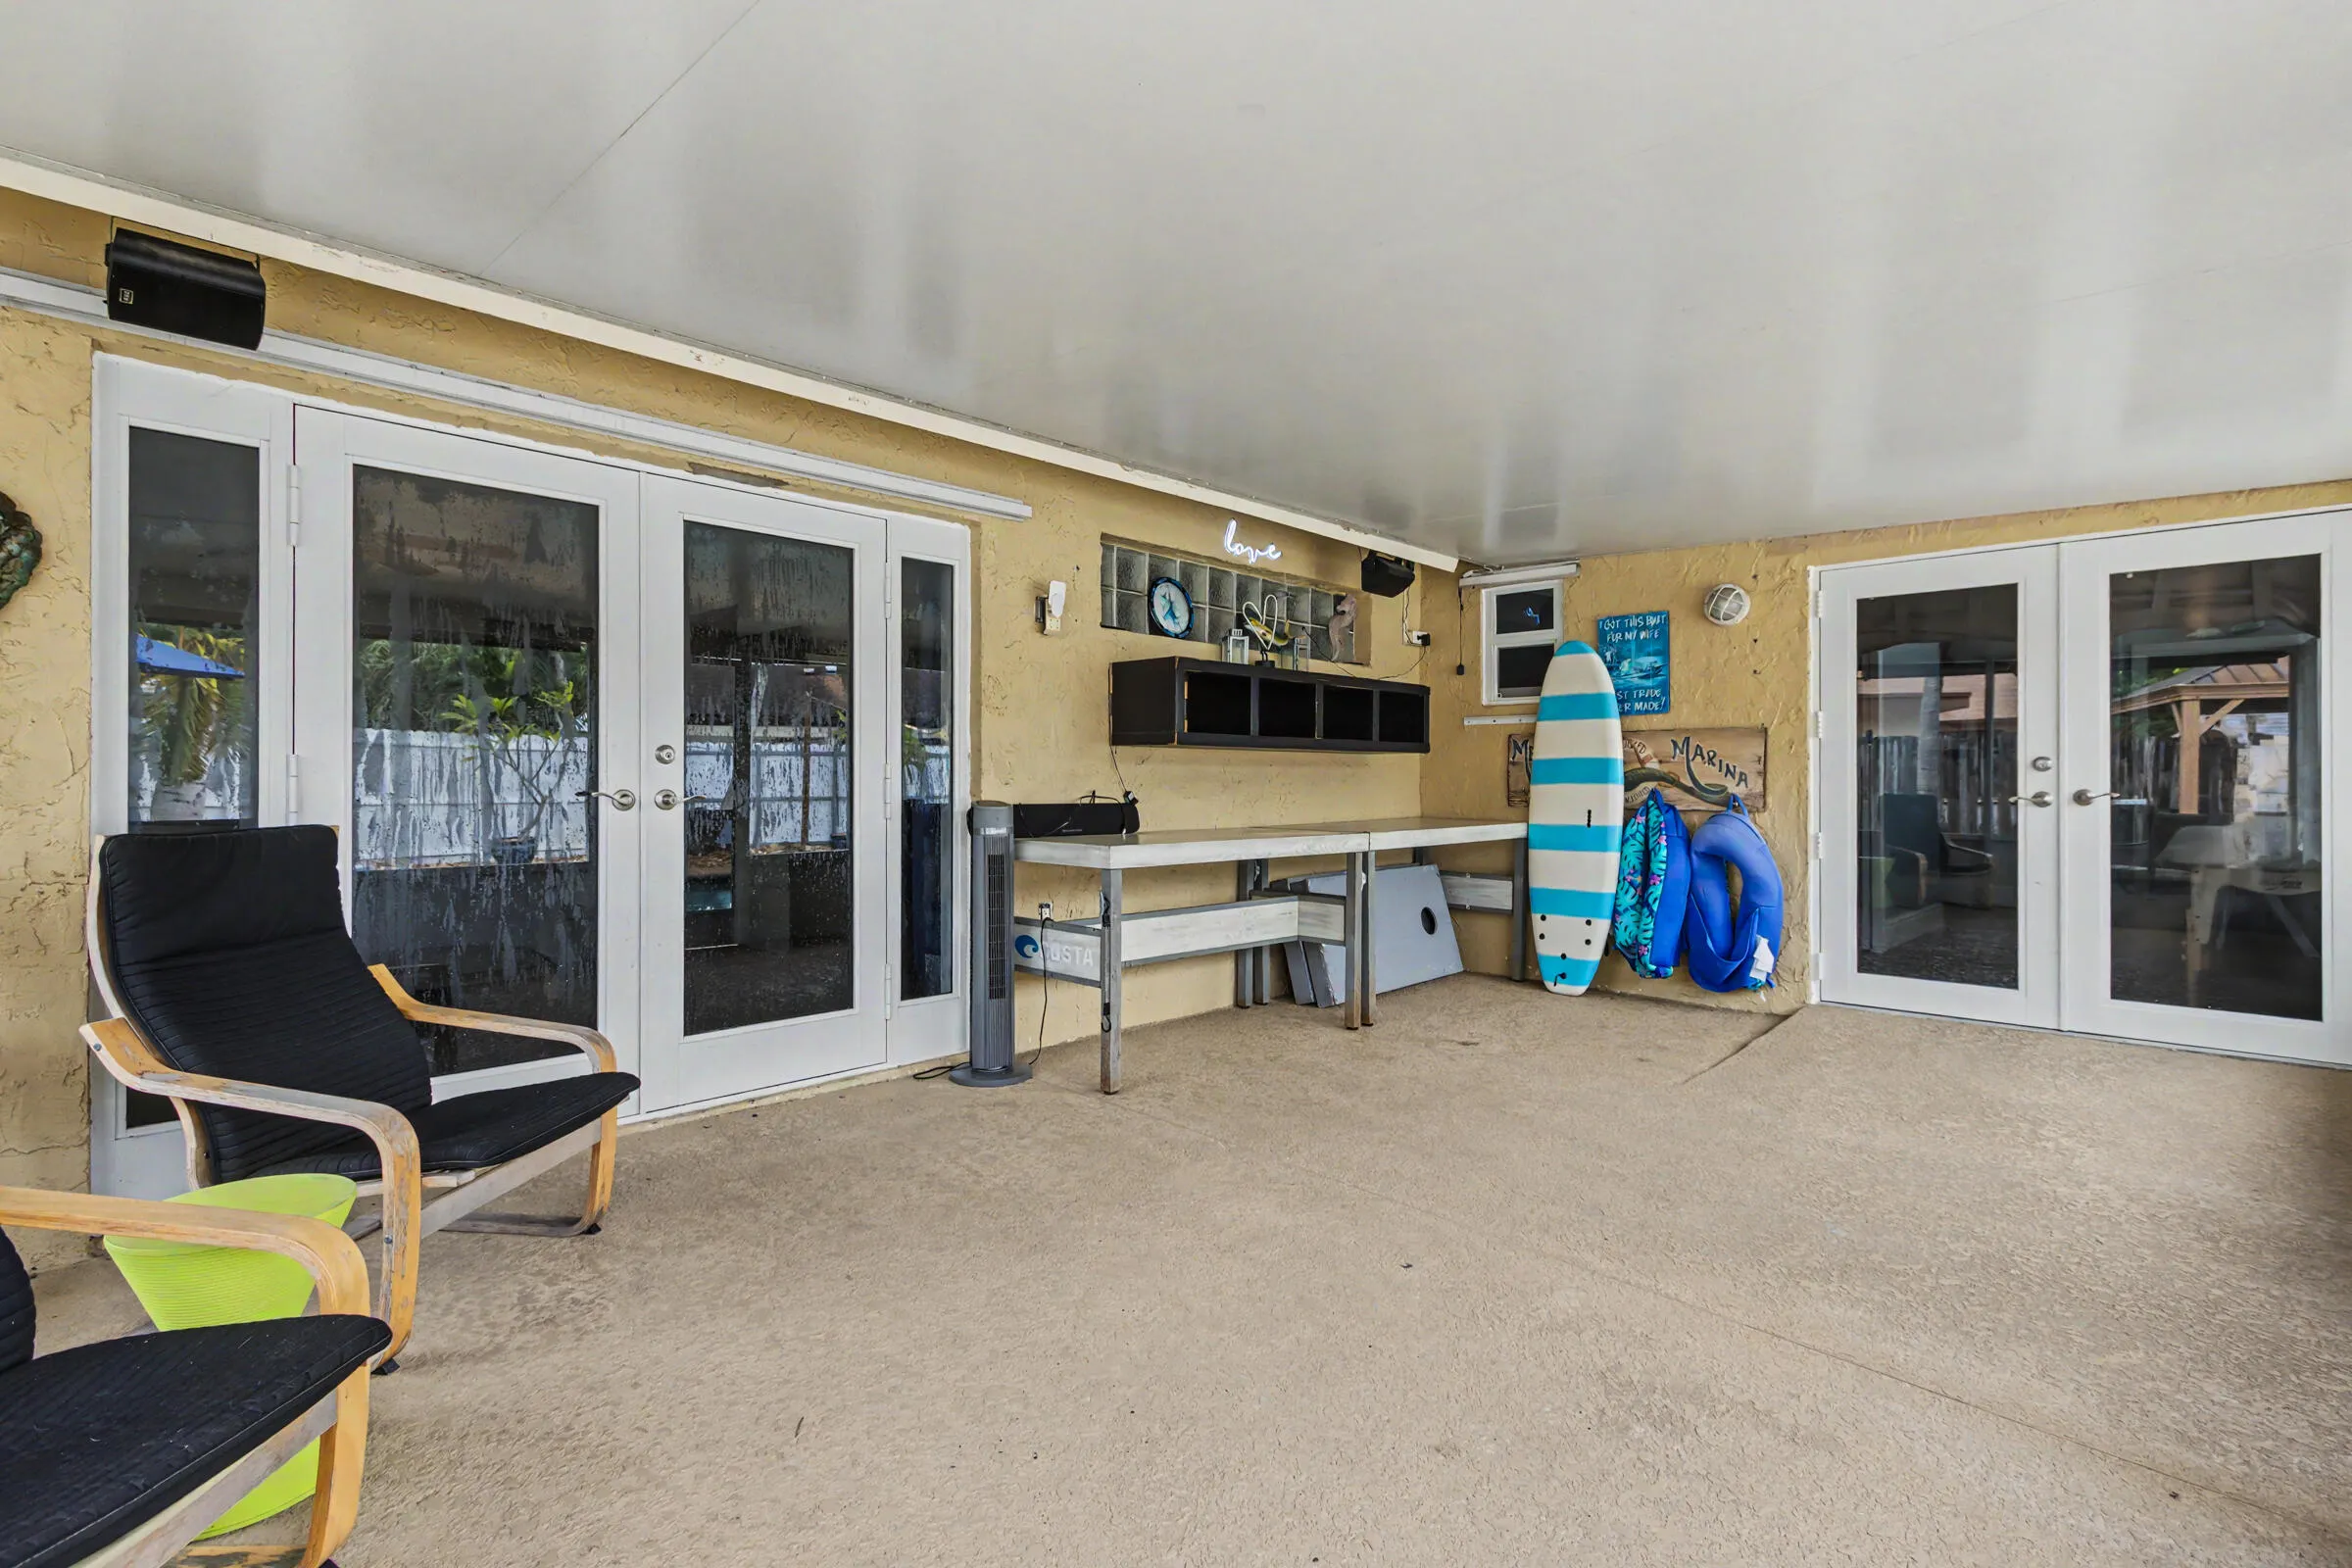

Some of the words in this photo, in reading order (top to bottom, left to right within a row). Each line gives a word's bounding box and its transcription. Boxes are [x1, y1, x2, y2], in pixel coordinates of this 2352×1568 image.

[1224, 517, 1282, 564] love
[1603, 618, 1621, 630] GOT
[1624, 615, 1644, 628] THIS
[1606, 631, 1623, 643] FOR
[1624, 629, 1638, 641] MY
[1640, 628, 1661, 640] WIFE
[1617, 690, 1629, 700] ST
[1633, 688, 1661, 699] TRADE
[1618, 702, 1632, 712] ER
[1670, 737, 1748, 796] MARINA
